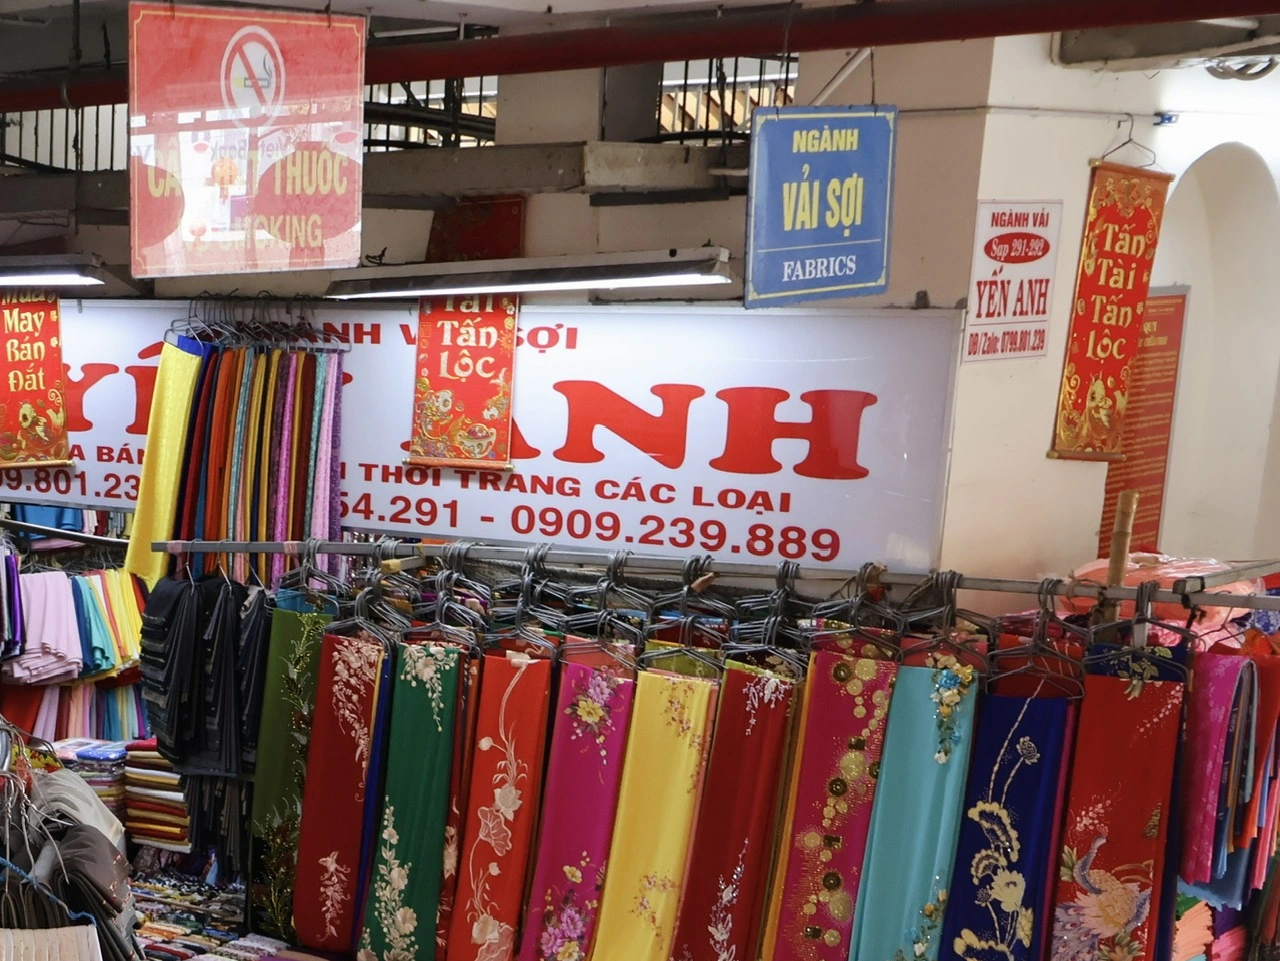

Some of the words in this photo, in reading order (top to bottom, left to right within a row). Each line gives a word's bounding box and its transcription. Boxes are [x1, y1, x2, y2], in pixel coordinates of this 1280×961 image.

[792, 125, 859, 153] NGÀNH
[783, 163, 820, 231] VẢI
[825, 173, 864, 237] SỢI
[223, 214, 323, 250] MOKING
[990, 208, 1029, 228] NGÀNH
[1032, 207, 1050, 228] VẢI
[990, 238, 1010, 261] Sạp
[1102, 223, 1147, 259] Tấn
[782, 255, 857, 282] FABRICS
[1096, 257, 1138, 291] Tài
[976, 265, 1011, 318] YẾN
[1012, 278, 1050, 317] ANH
[4, 309, 44, 338] May
[1090, 294, 1132, 329] Tấn
[6, 335, 45, 362] Bán
[437, 319, 498, 349] Tấn
[515, 323, 578, 353] ỢI
[8, 367, 46, 392] Đắt
[439, 350, 496, 382] Lộc
[454, 469, 581, 497] TRANG
[595, 477, 676, 504] CÁC
[692, 486, 791, 515] LOẠI
[510, 505, 841, 562] 0909.239.889
